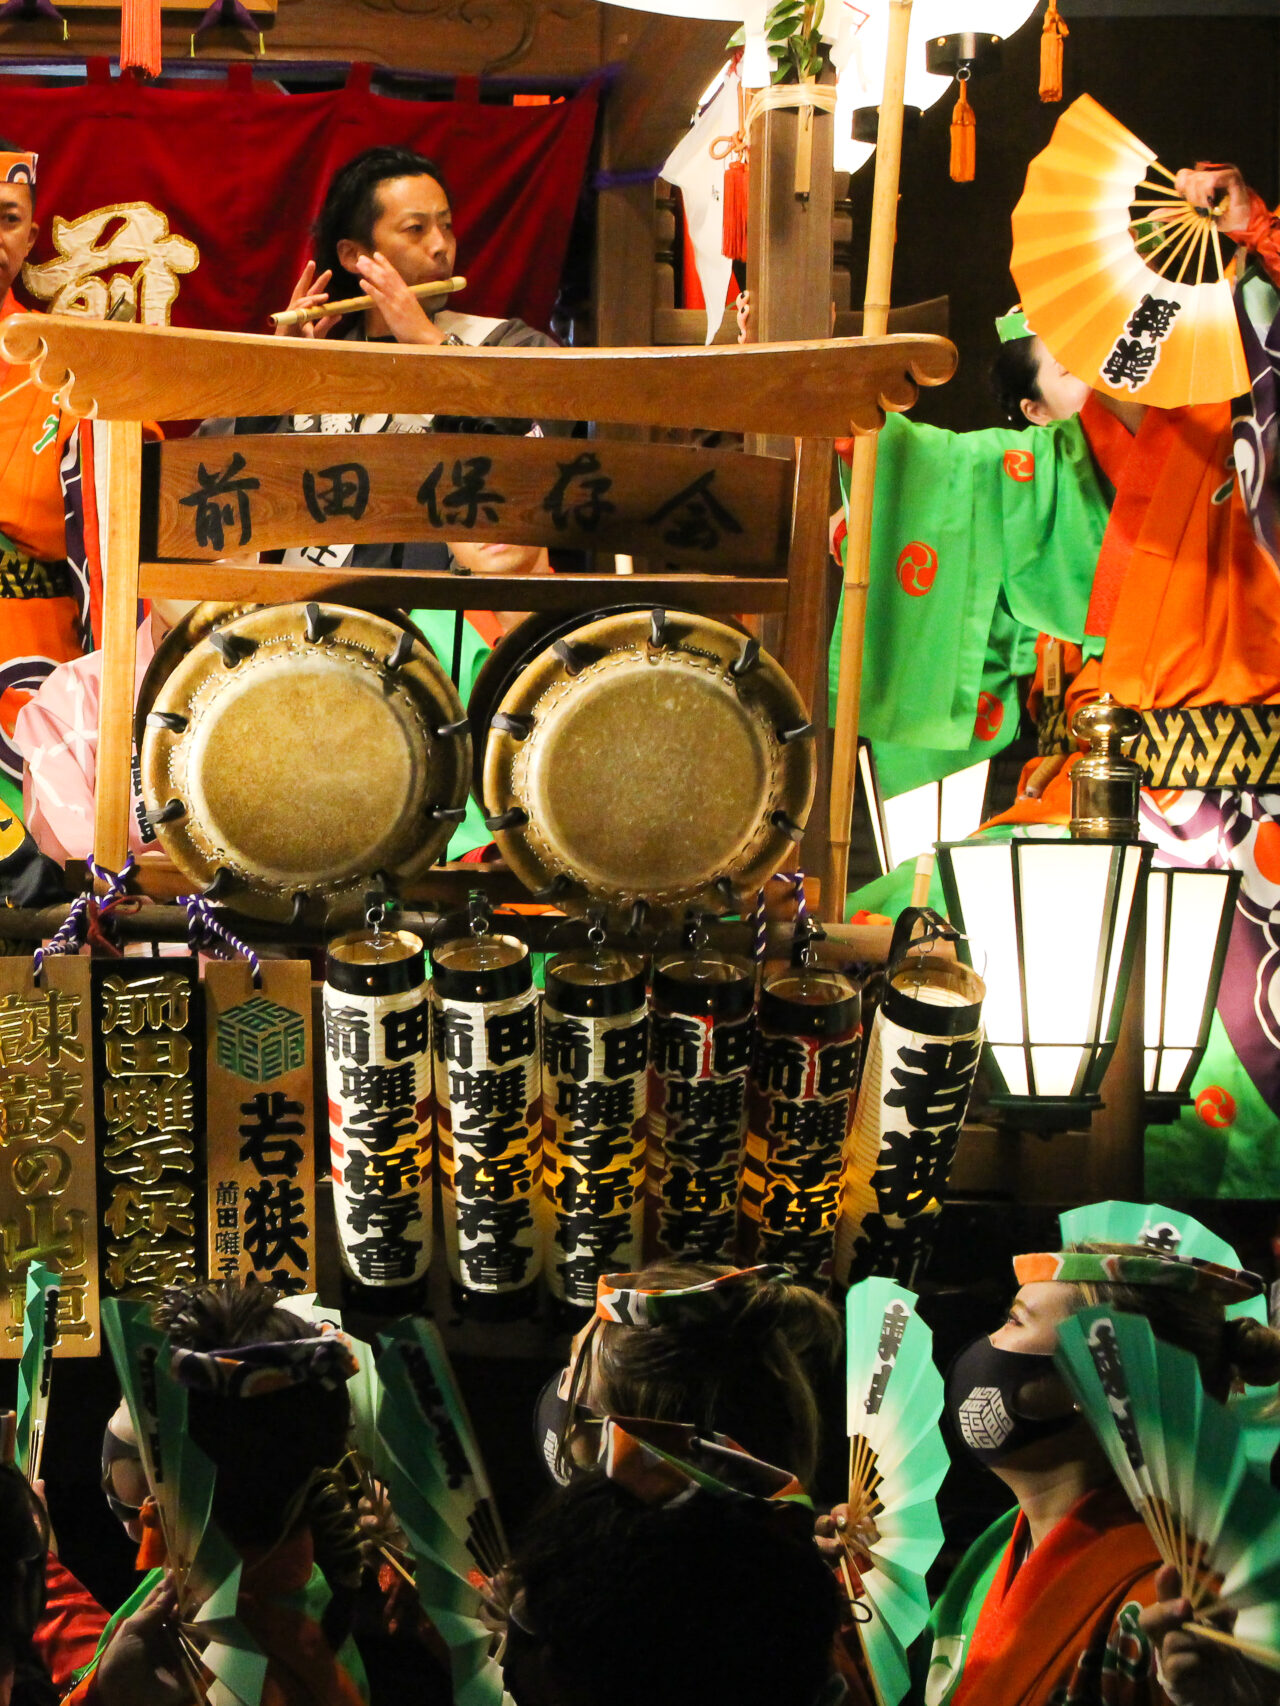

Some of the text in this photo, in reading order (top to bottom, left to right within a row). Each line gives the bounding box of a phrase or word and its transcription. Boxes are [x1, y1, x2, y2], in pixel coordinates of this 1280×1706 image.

[101, 972, 196, 1300] 前田囃子保存
